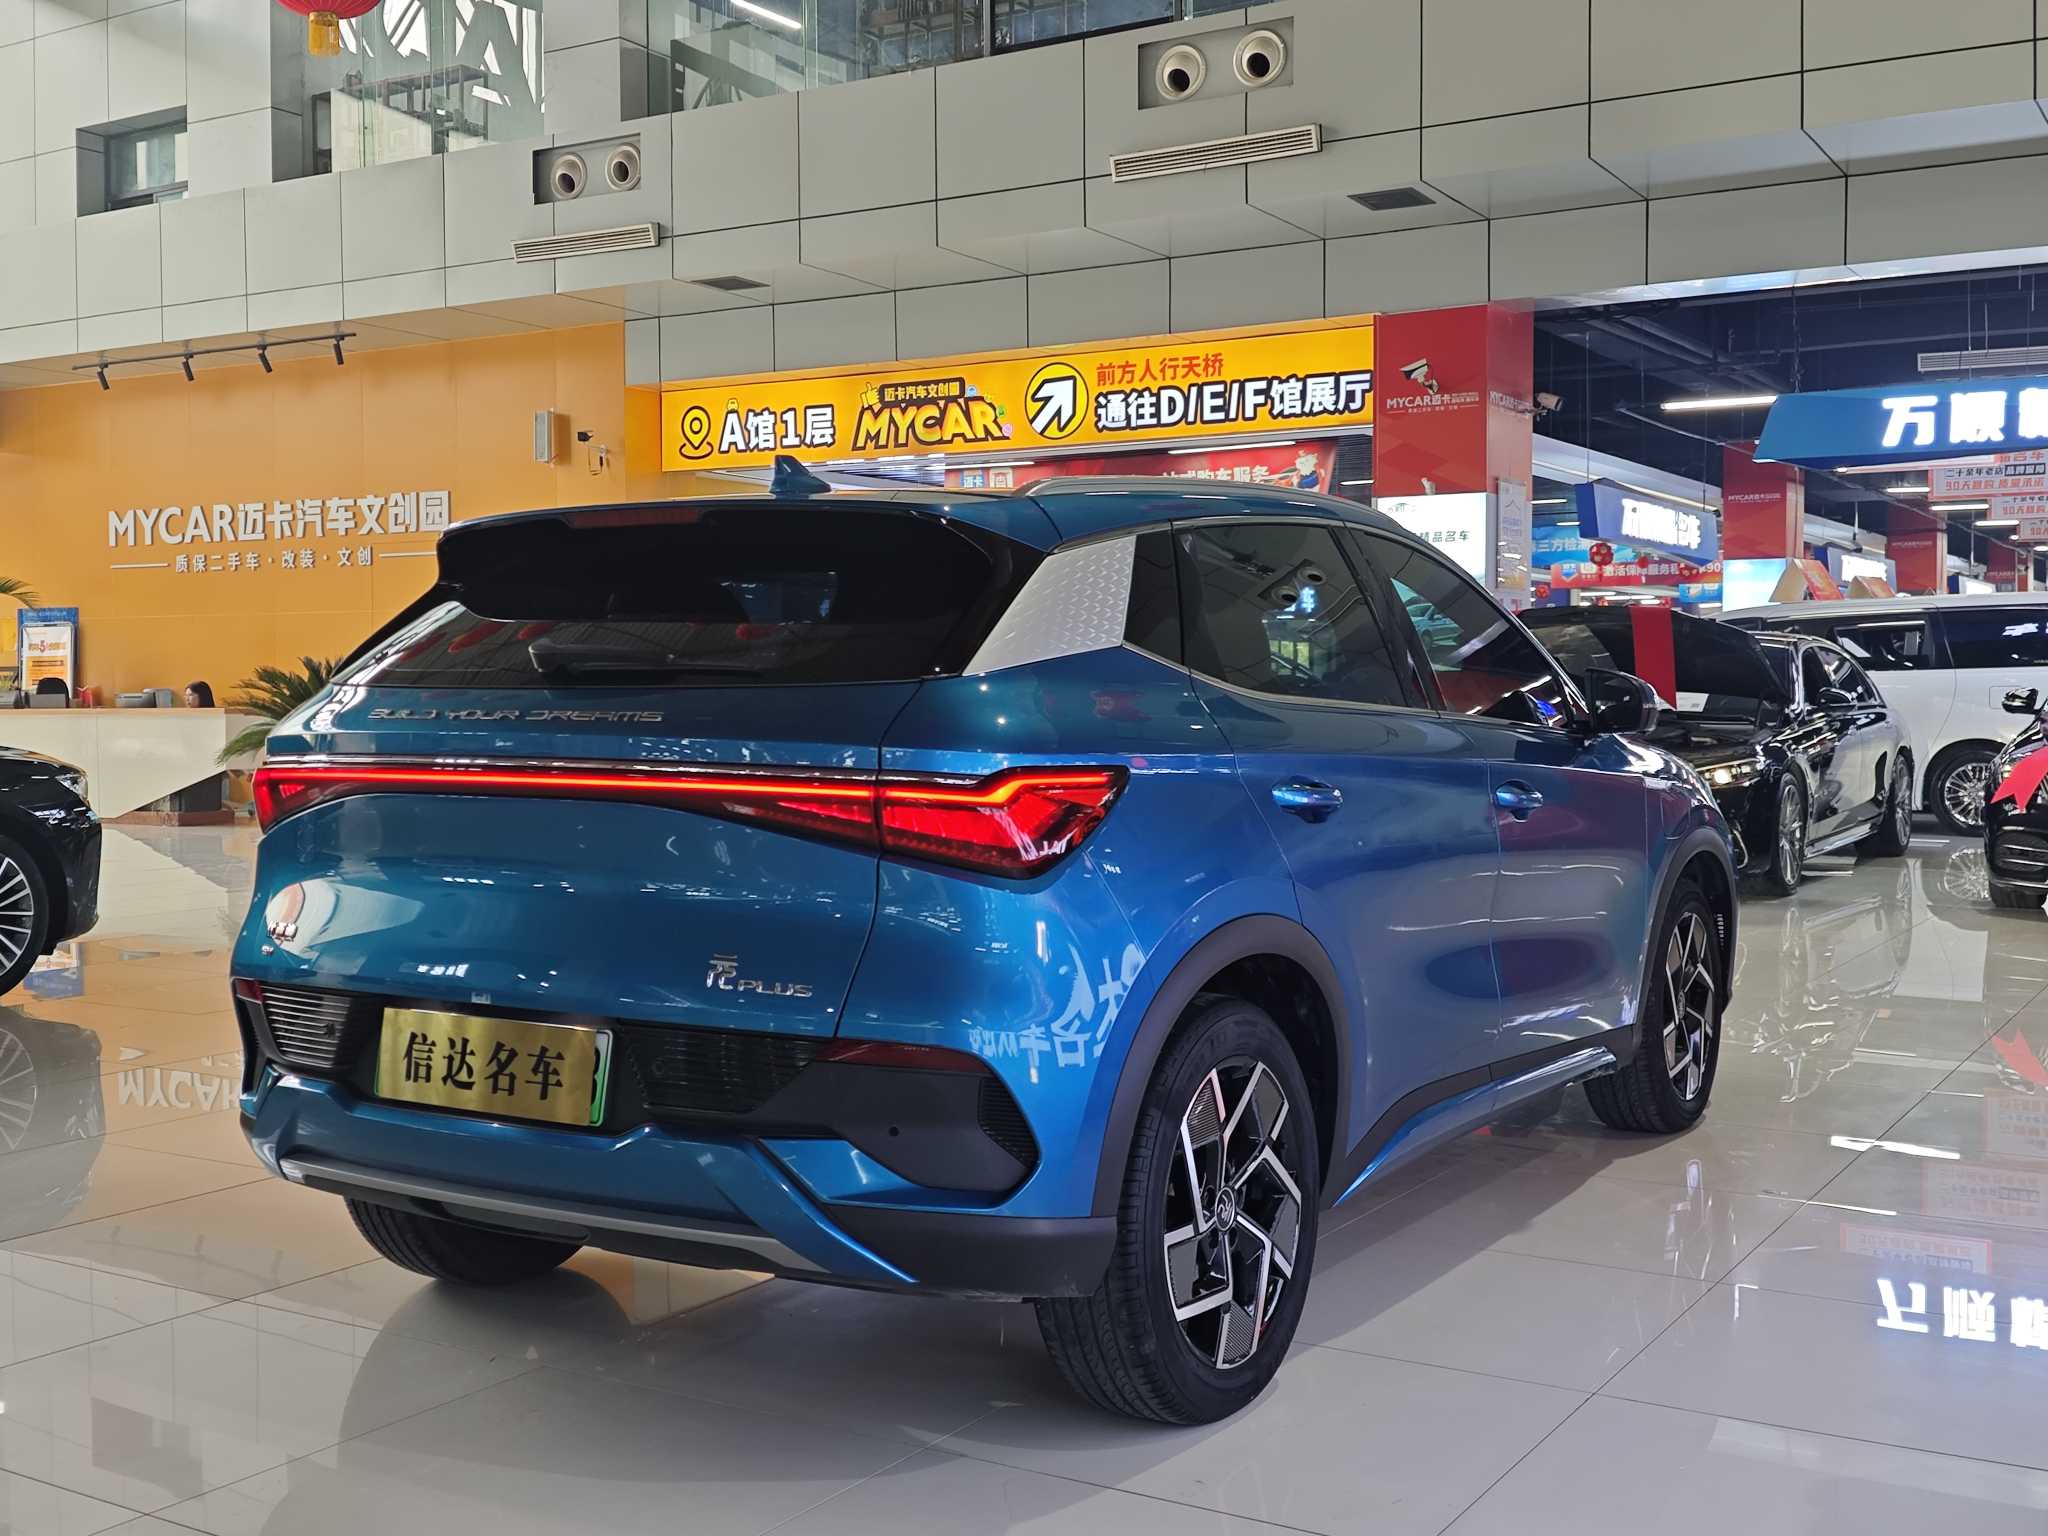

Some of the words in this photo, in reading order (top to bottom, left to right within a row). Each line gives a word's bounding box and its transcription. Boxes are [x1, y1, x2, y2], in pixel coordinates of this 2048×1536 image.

[1096, 353, 1224, 386] 前方人行天桥
[853, 400, 1006, 451] MYCAR
[1096, 372, 1372, 431] 通往D/E/F馆展厅
[719, 405, 836, 453] A馆1层
[1163, 465, 1271, 482] 购车服务
[108, 490, 450, 547] MYCAR迈卡汽车文创园
[446, 709, 520, 720] YOUR
[526, 709, 664, 722] DREAMS
[737, 979, 813, 997] PLUS
[403, 1032, 566, 1101] 信达名车
